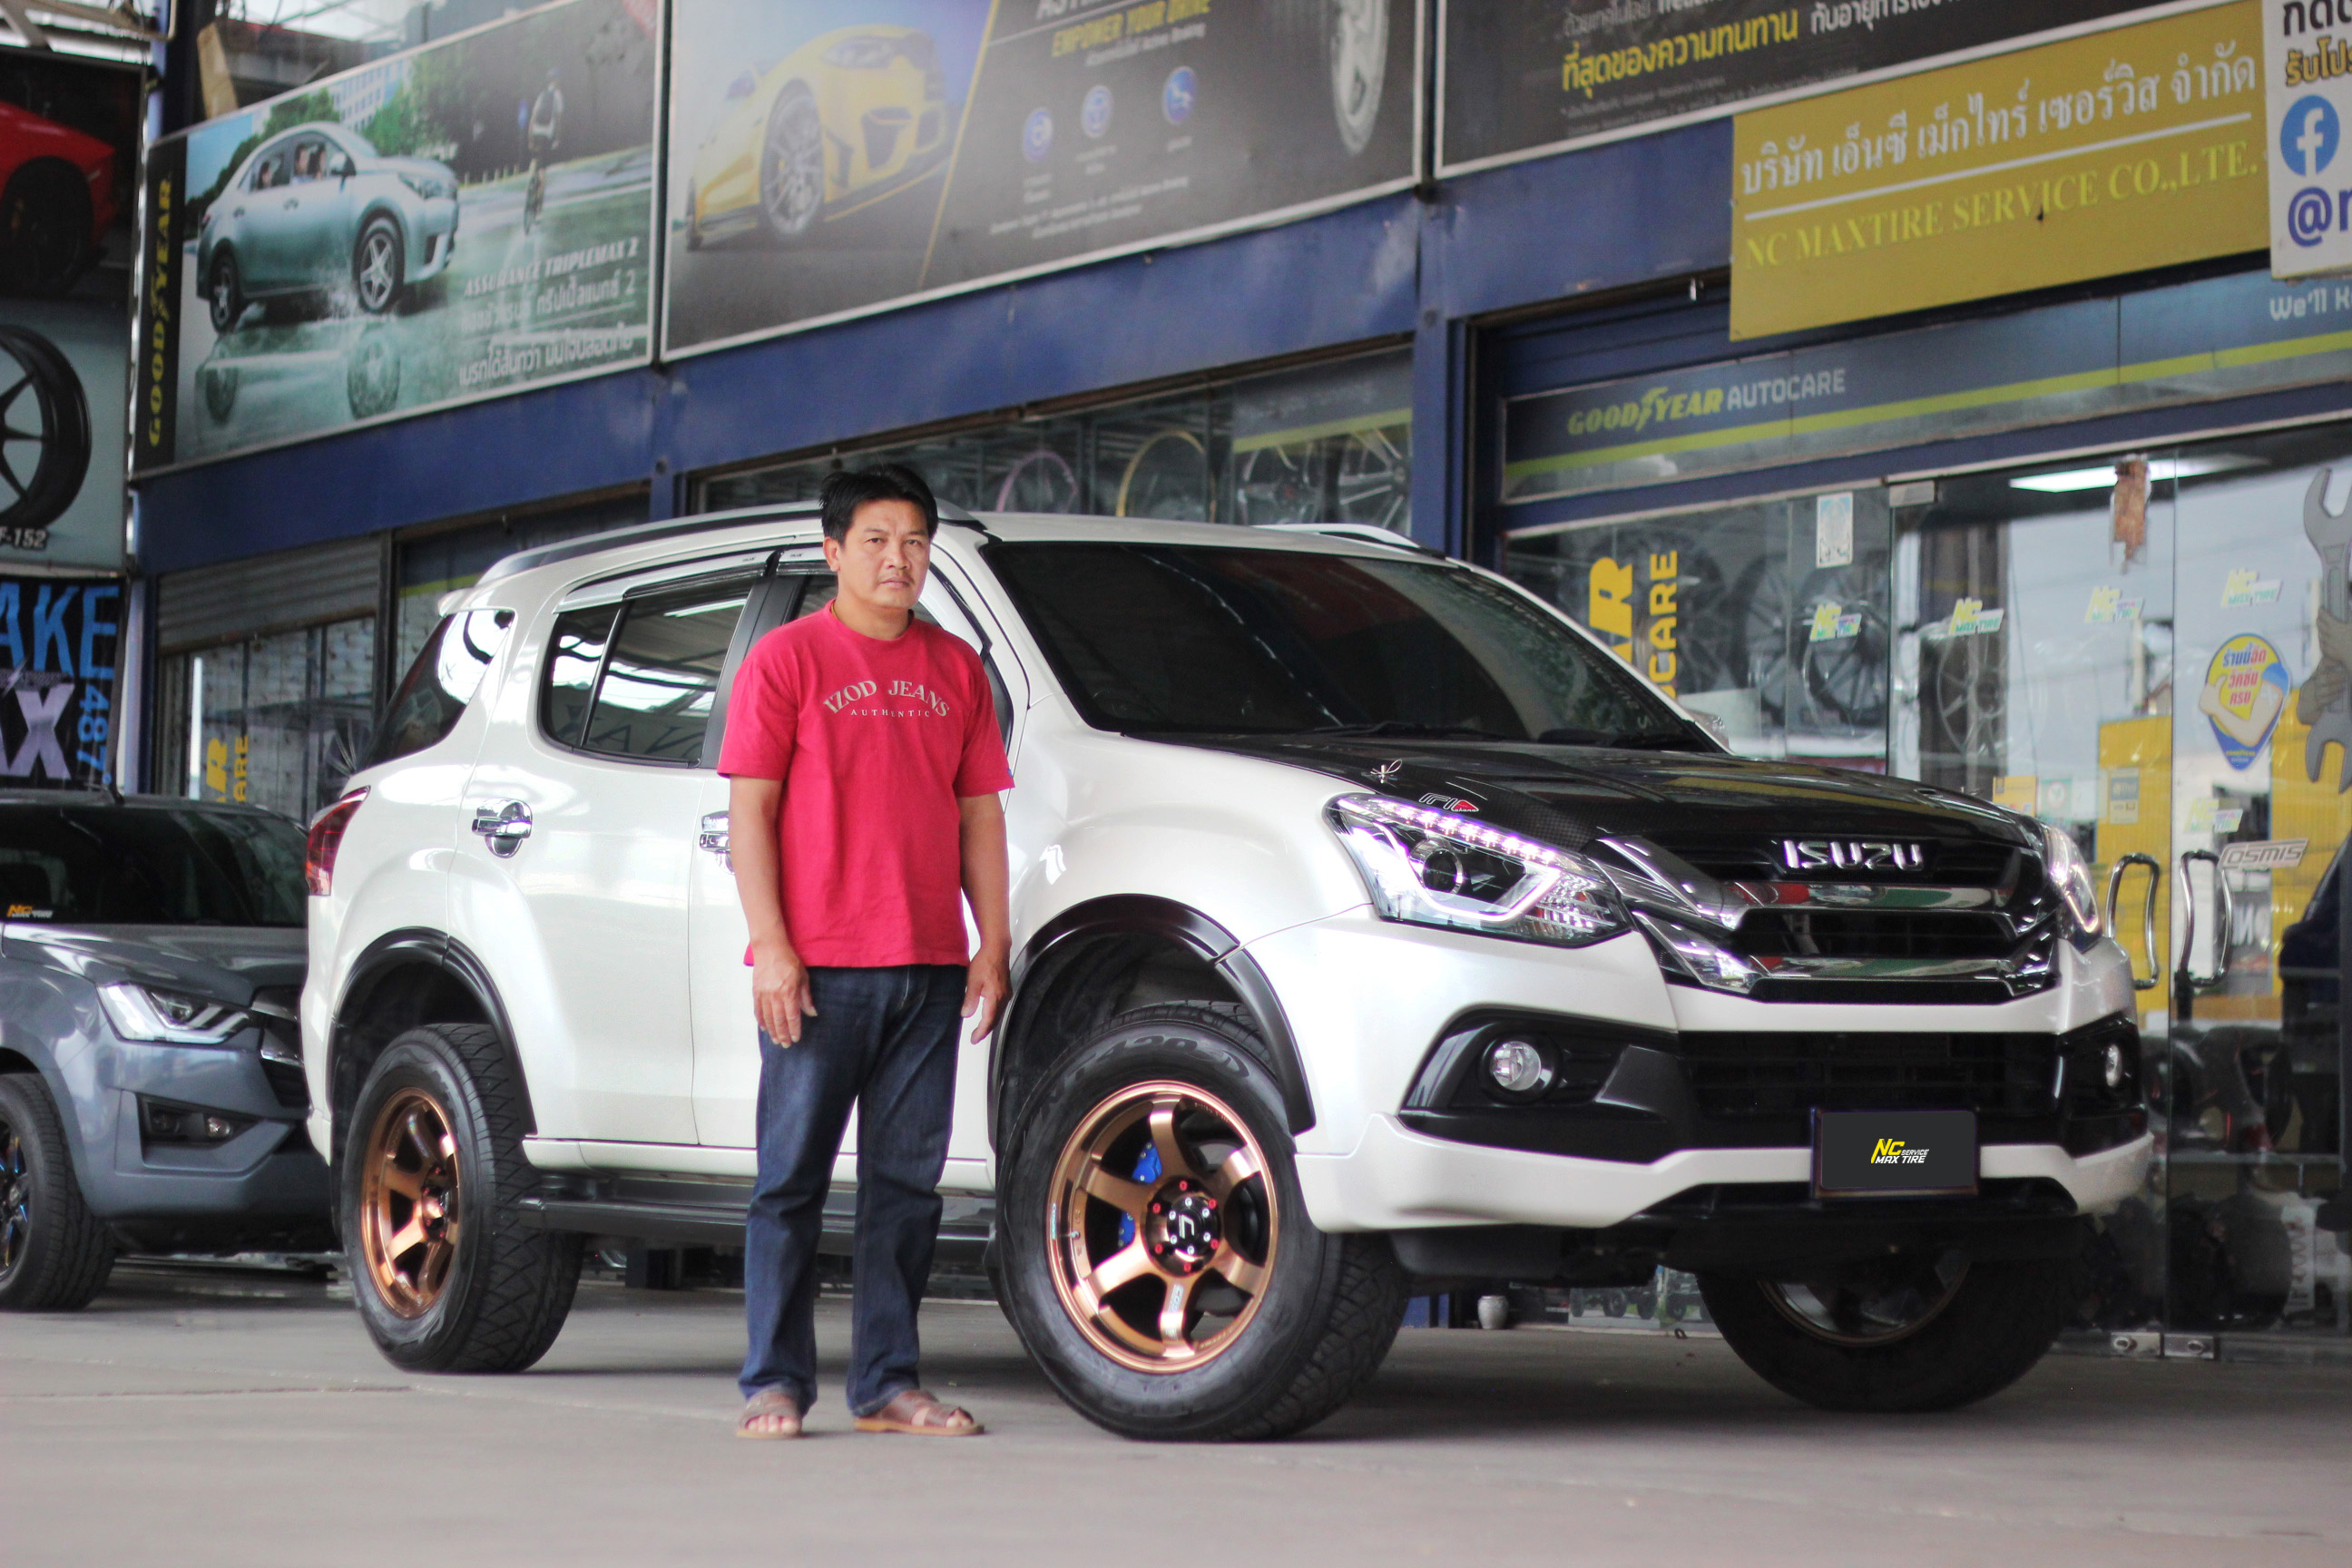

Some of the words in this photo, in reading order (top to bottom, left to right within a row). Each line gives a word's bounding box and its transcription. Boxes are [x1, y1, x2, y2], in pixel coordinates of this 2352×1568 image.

[1563, 9, 1798, 99] ที่สุดของความทนทาน
[1740, 134, 1823, 195] บริษัท
[1832, 110, 1908, 177] เอ็นซี
[2039, 58, 2160, 133] เซอร์วิส
[2171, 40, 2256, 104] จำกัด
[1746, 230, 1788, 269] NC
[1796, 200, 1944, 261] MAXTIRE
[1953, 170, 2099, 231] SERVICE
[465, 260, 543, 299] ASSURANCE
[2335, 285, 2352, 311] K
[146, 177, 174, 446] GOODYEAR
[1567, 387, 1723, 436] GOODYEAR
[1727, 368, 1847, 410] AUTOCARE
[823, 681, 877, 714] IZOD
[887, 681, 950, 717] JEANS
[851, 709, 930, 718] AUTHENTIC
[1782, 839, 1924, 871] ISUZU
